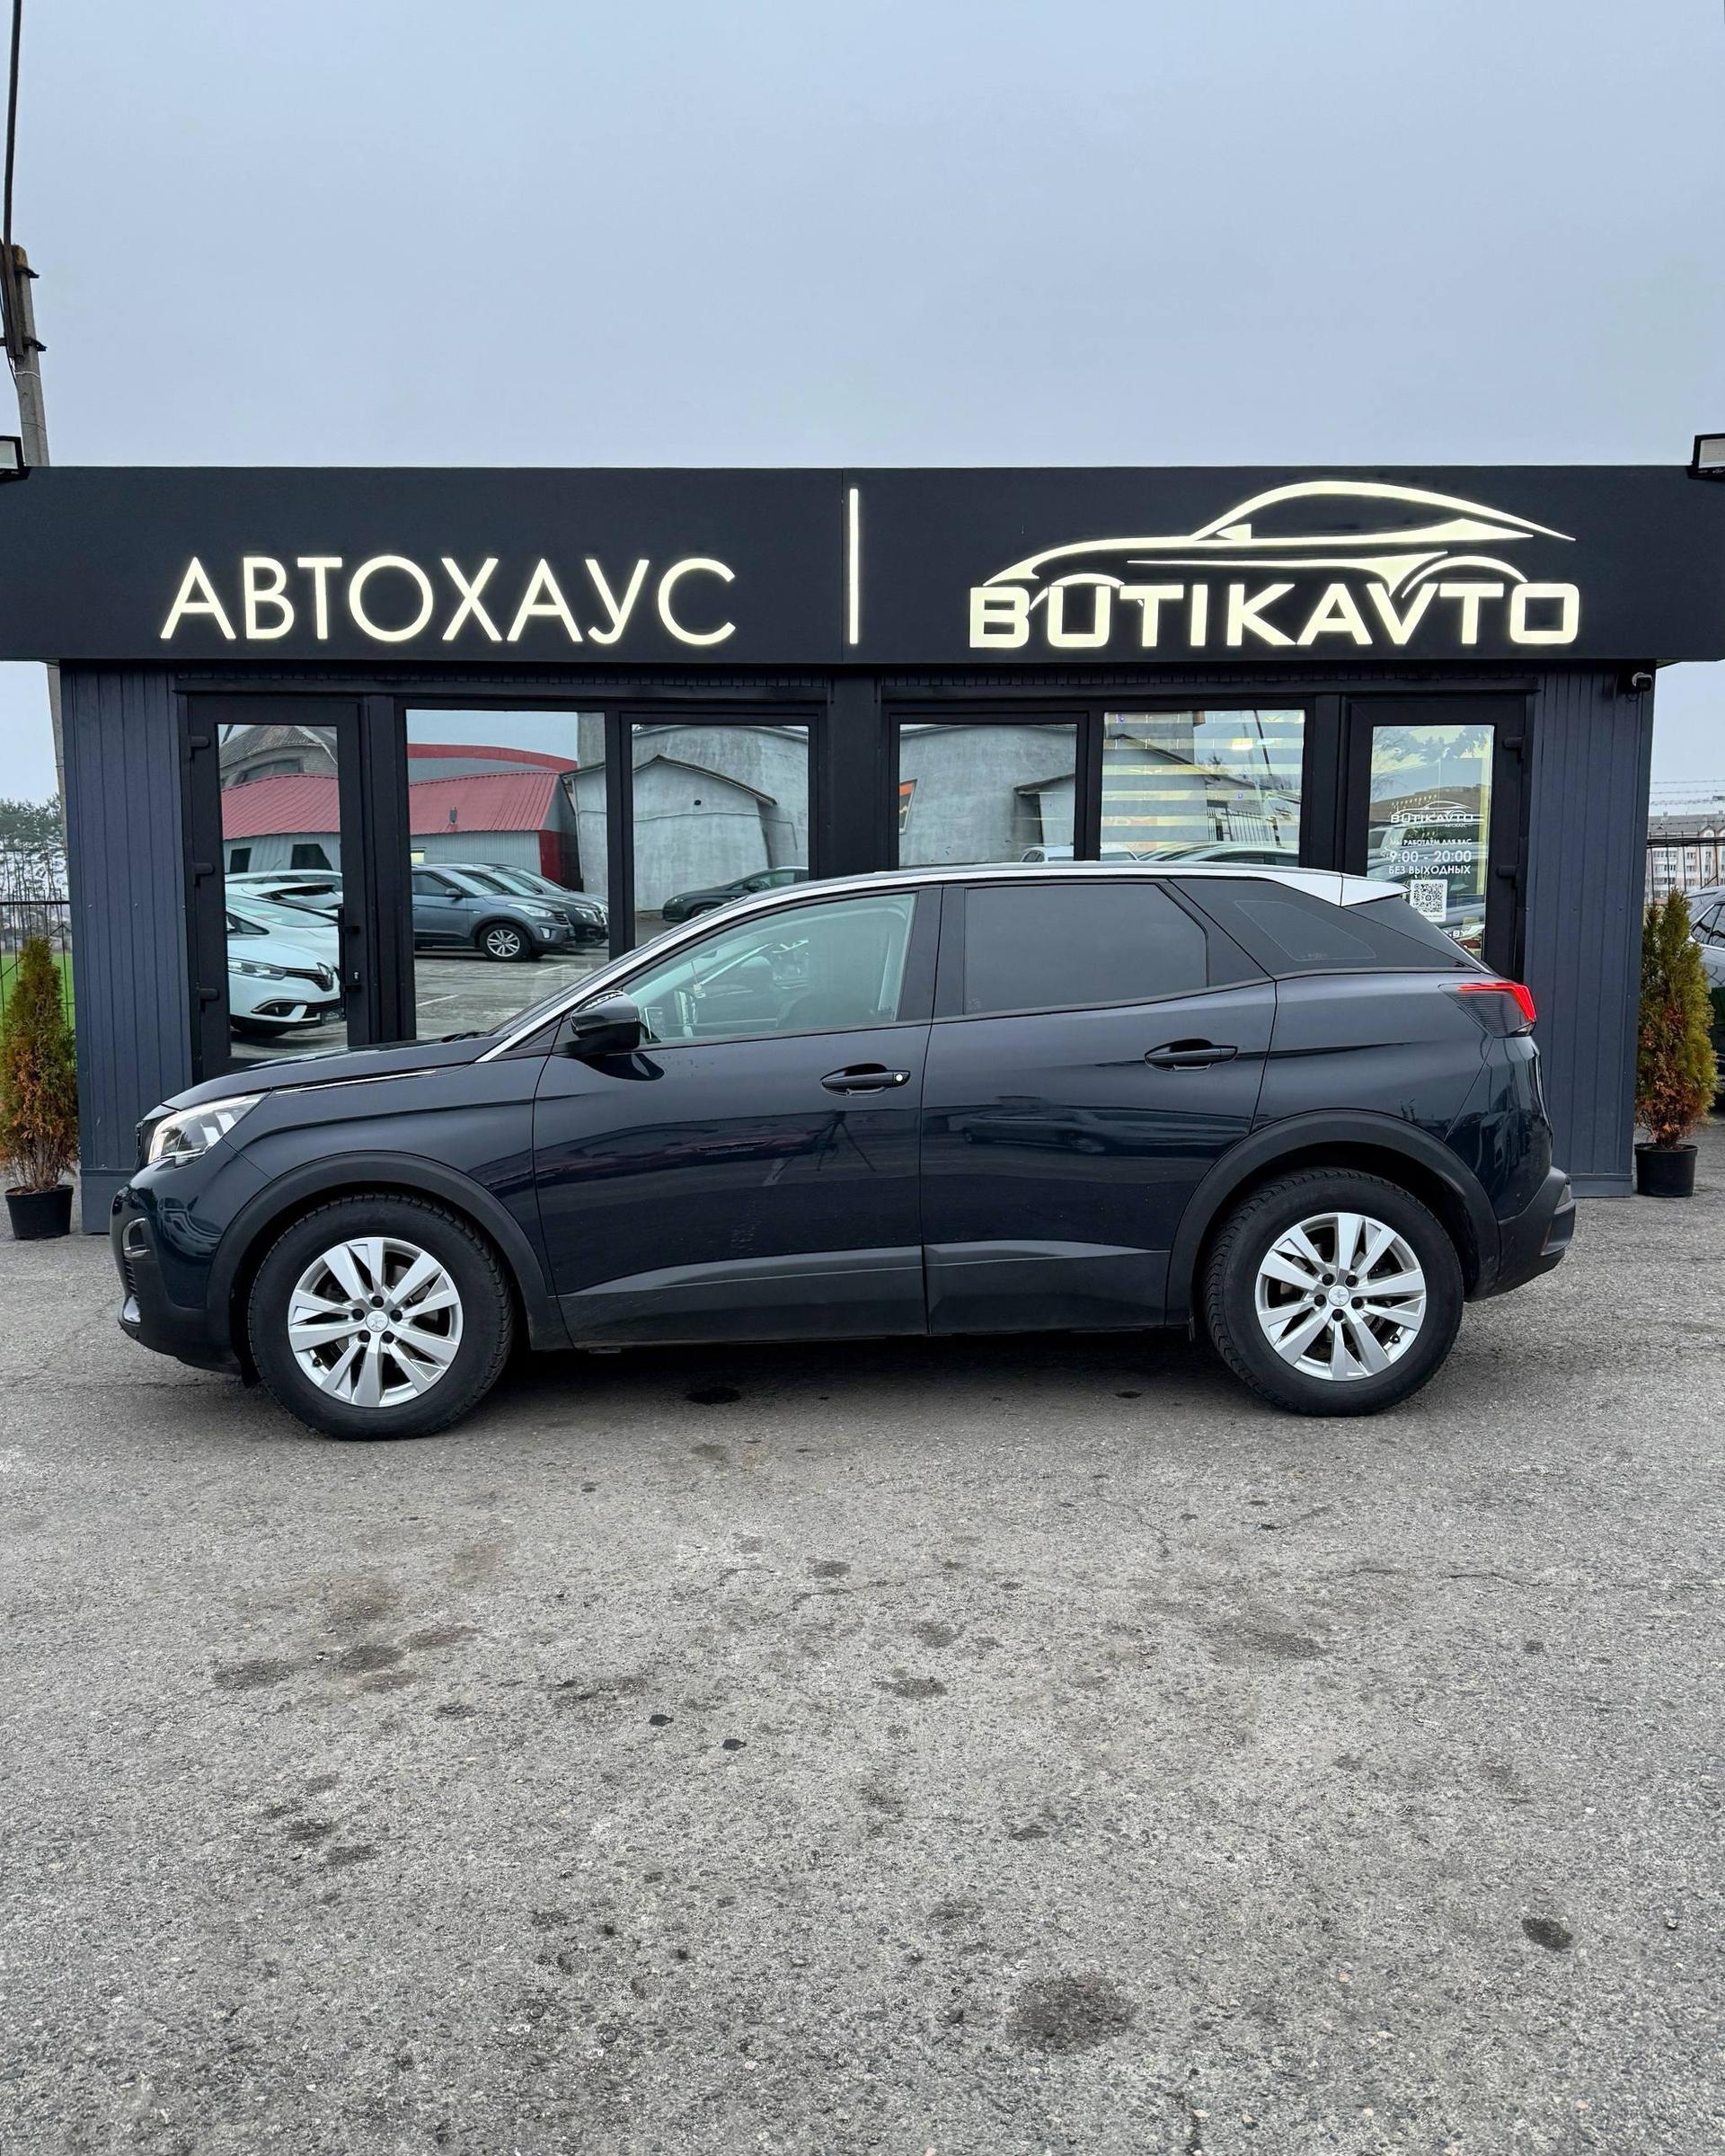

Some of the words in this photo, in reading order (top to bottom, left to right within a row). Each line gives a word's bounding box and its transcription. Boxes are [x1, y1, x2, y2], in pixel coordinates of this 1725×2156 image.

[160, 555, 736, 646] АВТОХАУС
[969, 581, 1580, 649] BUTIKAVTO
[1390, 813, 1473, 824] BUTIKAVTO
[1390, 851, 1419, 862] 9:00
[1433, 850, 1472, 862] 20:00
[1388, 866, 1406, 874] БЕЗ
[1409, 865, 1472, 875] ВЫХОДНЫХ
